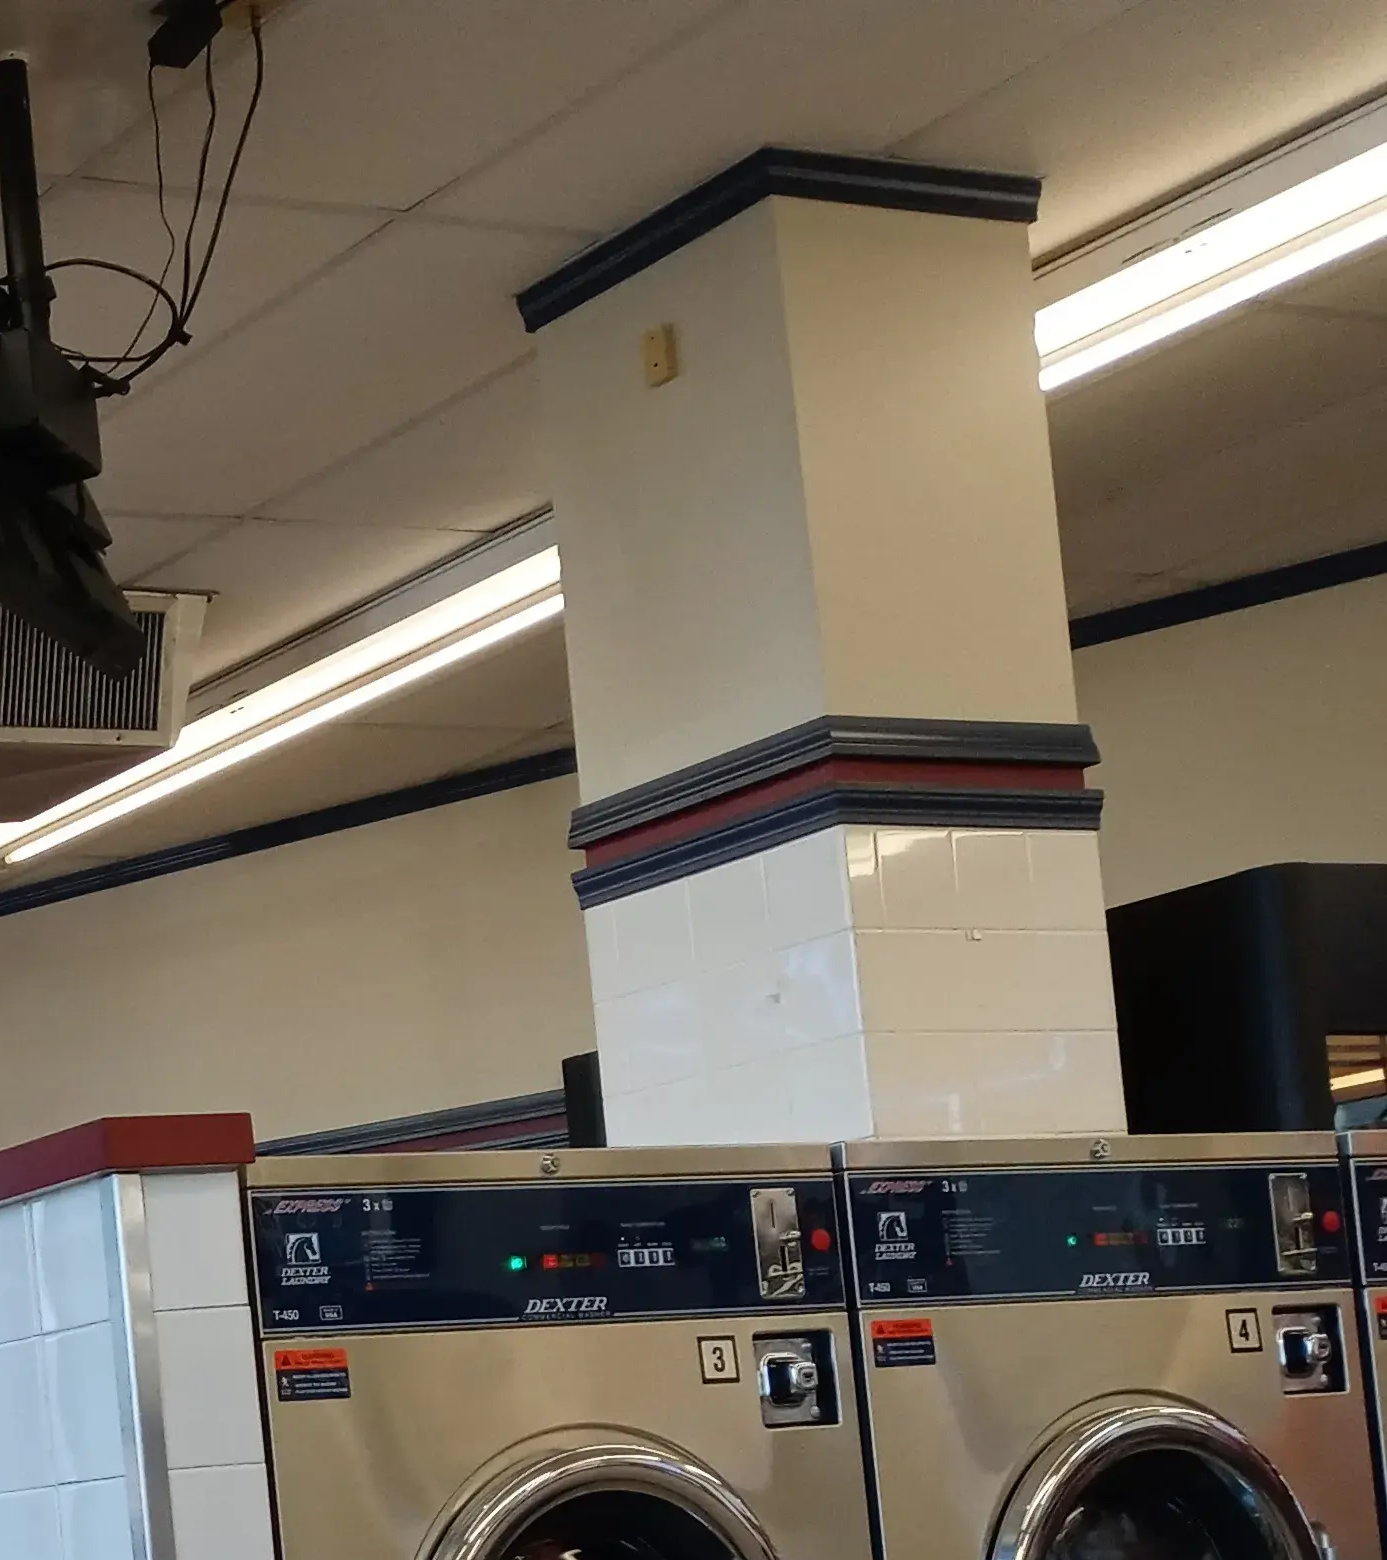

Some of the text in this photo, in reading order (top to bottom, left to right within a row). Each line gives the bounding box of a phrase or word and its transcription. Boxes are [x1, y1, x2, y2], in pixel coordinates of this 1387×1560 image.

[281, 1266, 330, 1277] DEXTER
[1079, 1271, 1150, 1288] DEXTER
[524, 1296, 608, 1314] DEXTER
[272, 1309, 300, 1321] T-450
[1238, 1318, 1250, 1342] 4
[712, 1346, 727, 1373] 3
